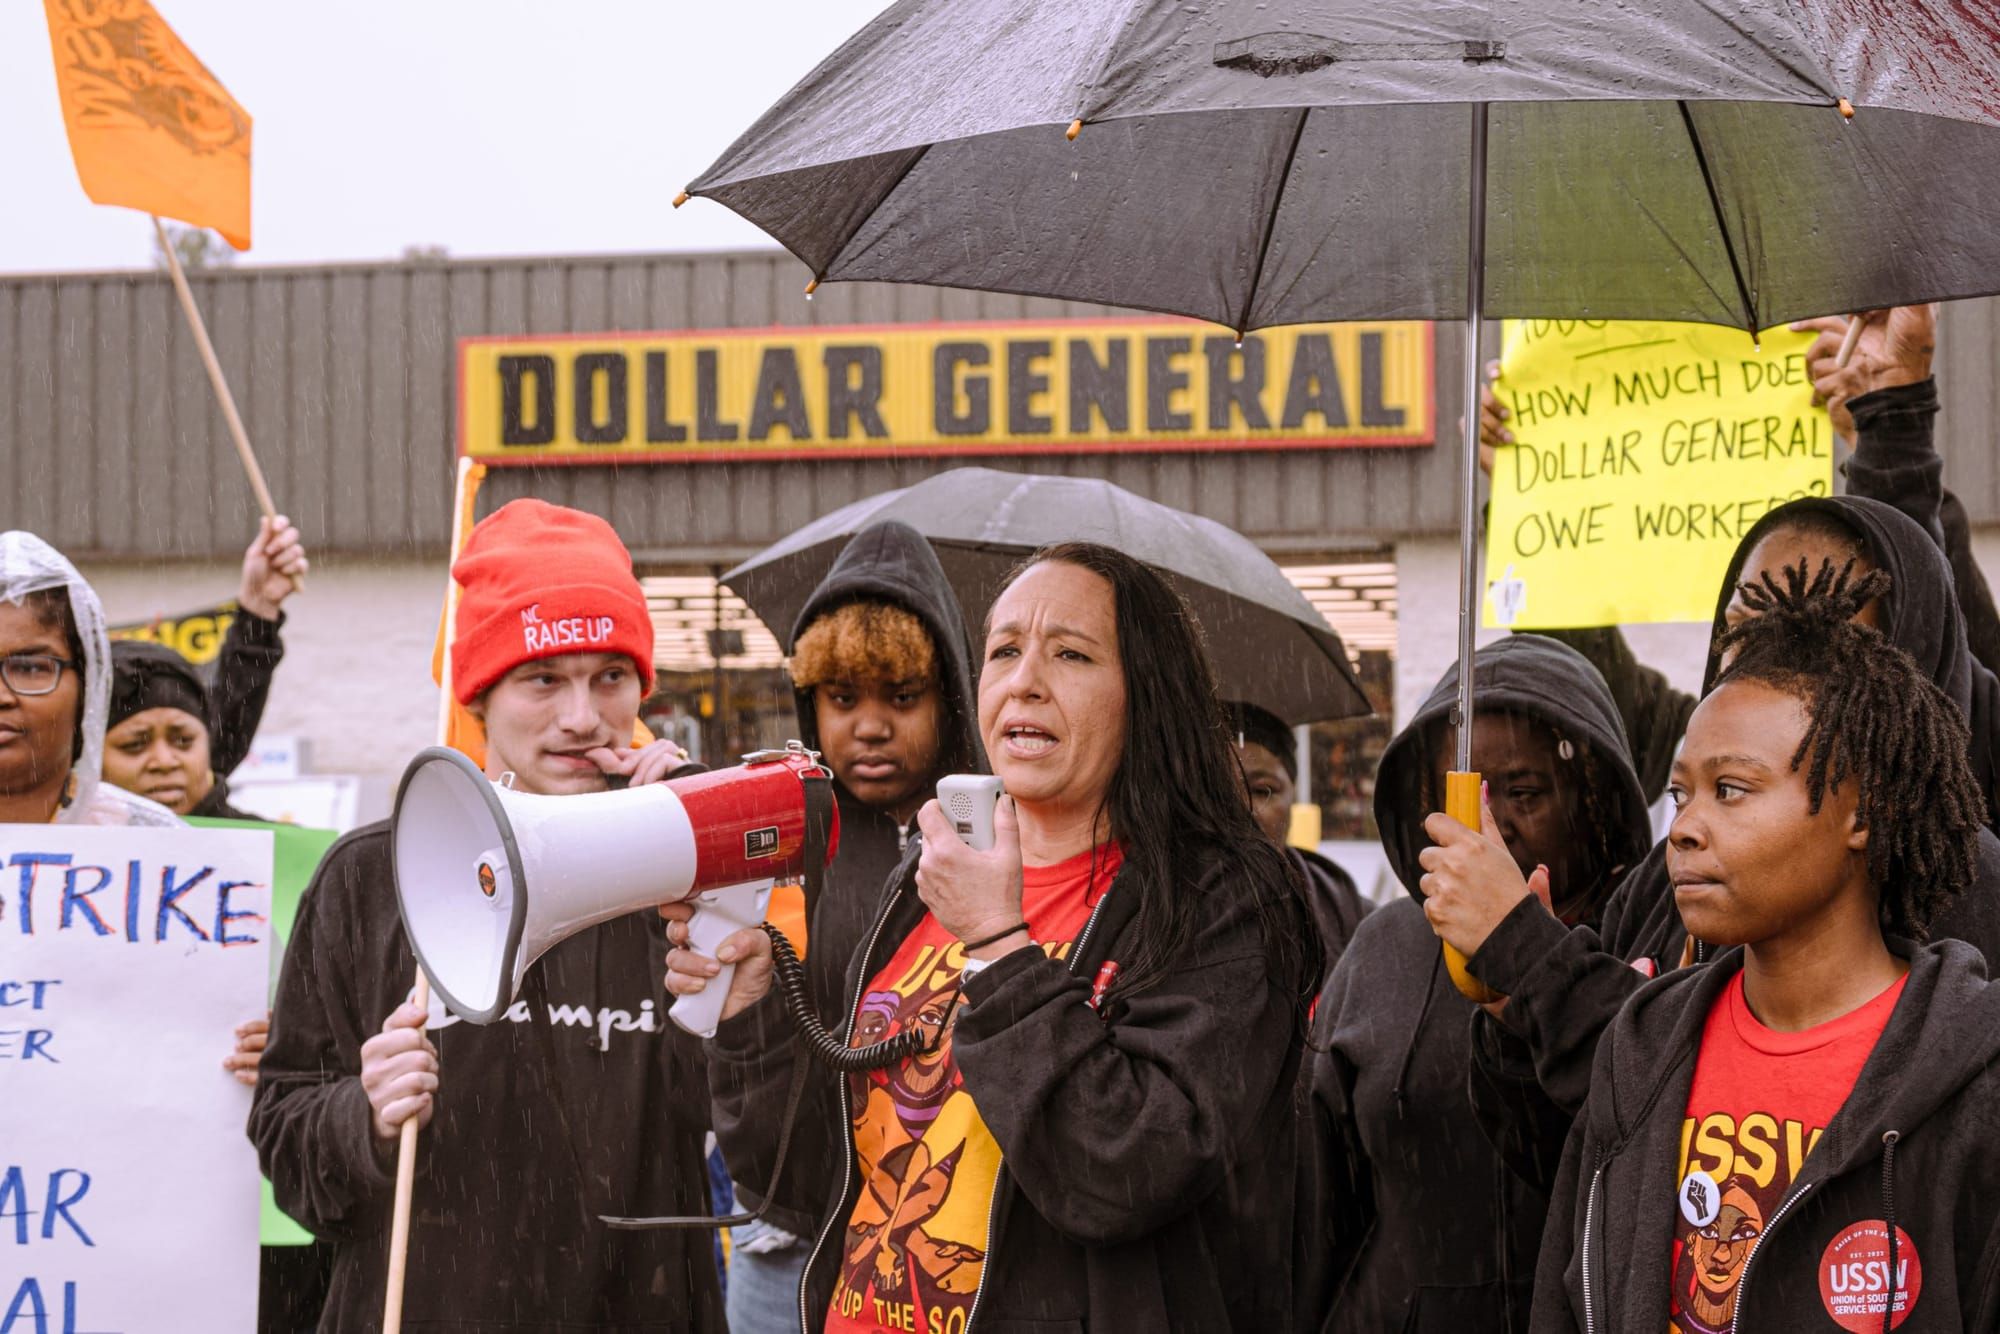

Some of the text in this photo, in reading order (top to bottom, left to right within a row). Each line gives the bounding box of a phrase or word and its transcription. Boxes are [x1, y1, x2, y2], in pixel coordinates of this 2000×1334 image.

[498, 332, 1408, 446] DOLLAR GENERAL
[1511, 353, 1815, 427] HOW MUCH DOE
[1515, 416, 1828, 493] DOLLAR GENERAL
[1514, 503, 1614, 557] OWE
[521, 604, 543, 626] NC
[524, 617, 614, 653] RAISE UP
[0, 852, 266, 947] TRIKE
[1830, 1259, 1907, 1293] USSW
[1830, 1291, 1908, 1305] UNION of SOUTERN
[842, 1287, 863, 1319] UP
[873, 1298, 915, 1332] THE
[1834, 1302, 1905, 1315] SERVICE WORERS
